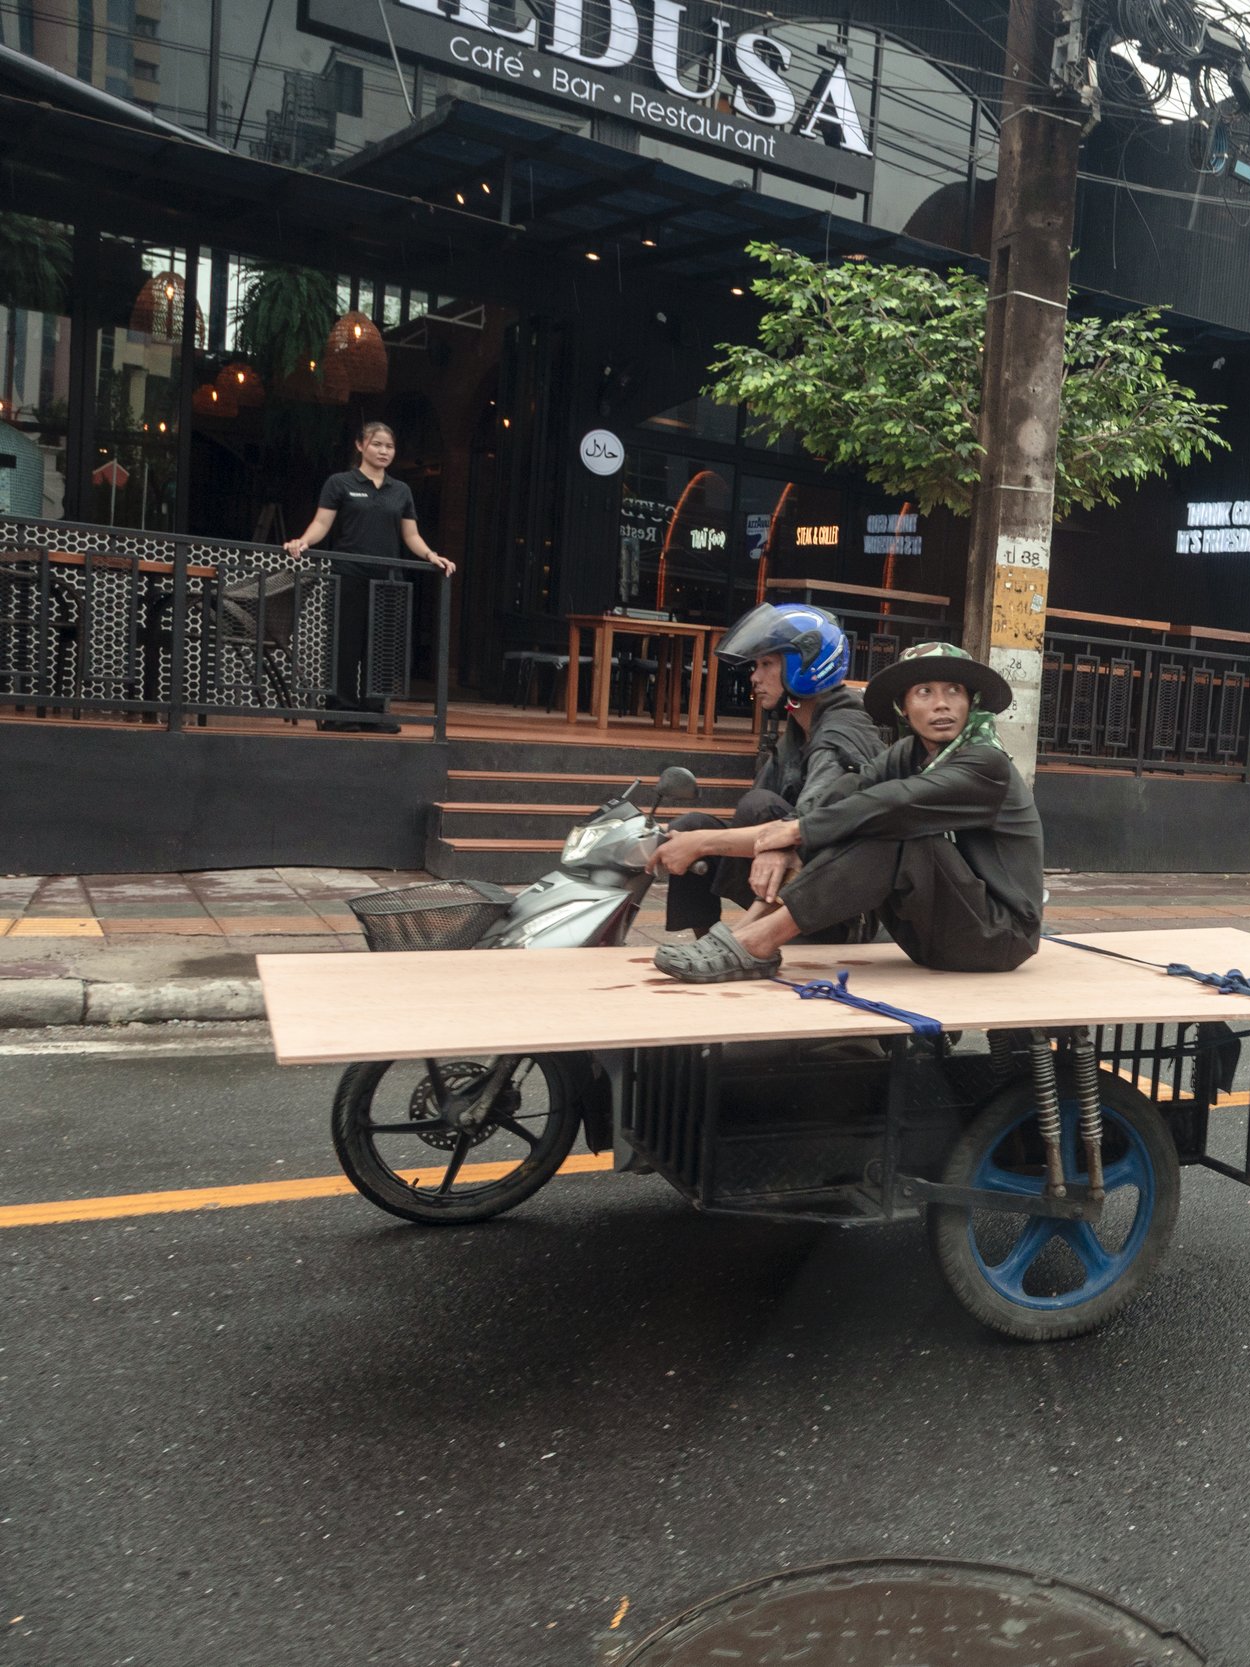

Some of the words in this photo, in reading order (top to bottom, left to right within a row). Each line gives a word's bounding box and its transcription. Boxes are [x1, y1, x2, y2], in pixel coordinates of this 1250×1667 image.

[397, 0, 873, 156] DUSA
[450, 36, 525, 78] Café
[552, 68, 604, 103] Bar
[629, 92, 778, 159] Restaurant
[585, 438, 618, 459] حلال
[1187, 502, 1232, 526] THANK
[796, 527, 812, 546] STEAK
